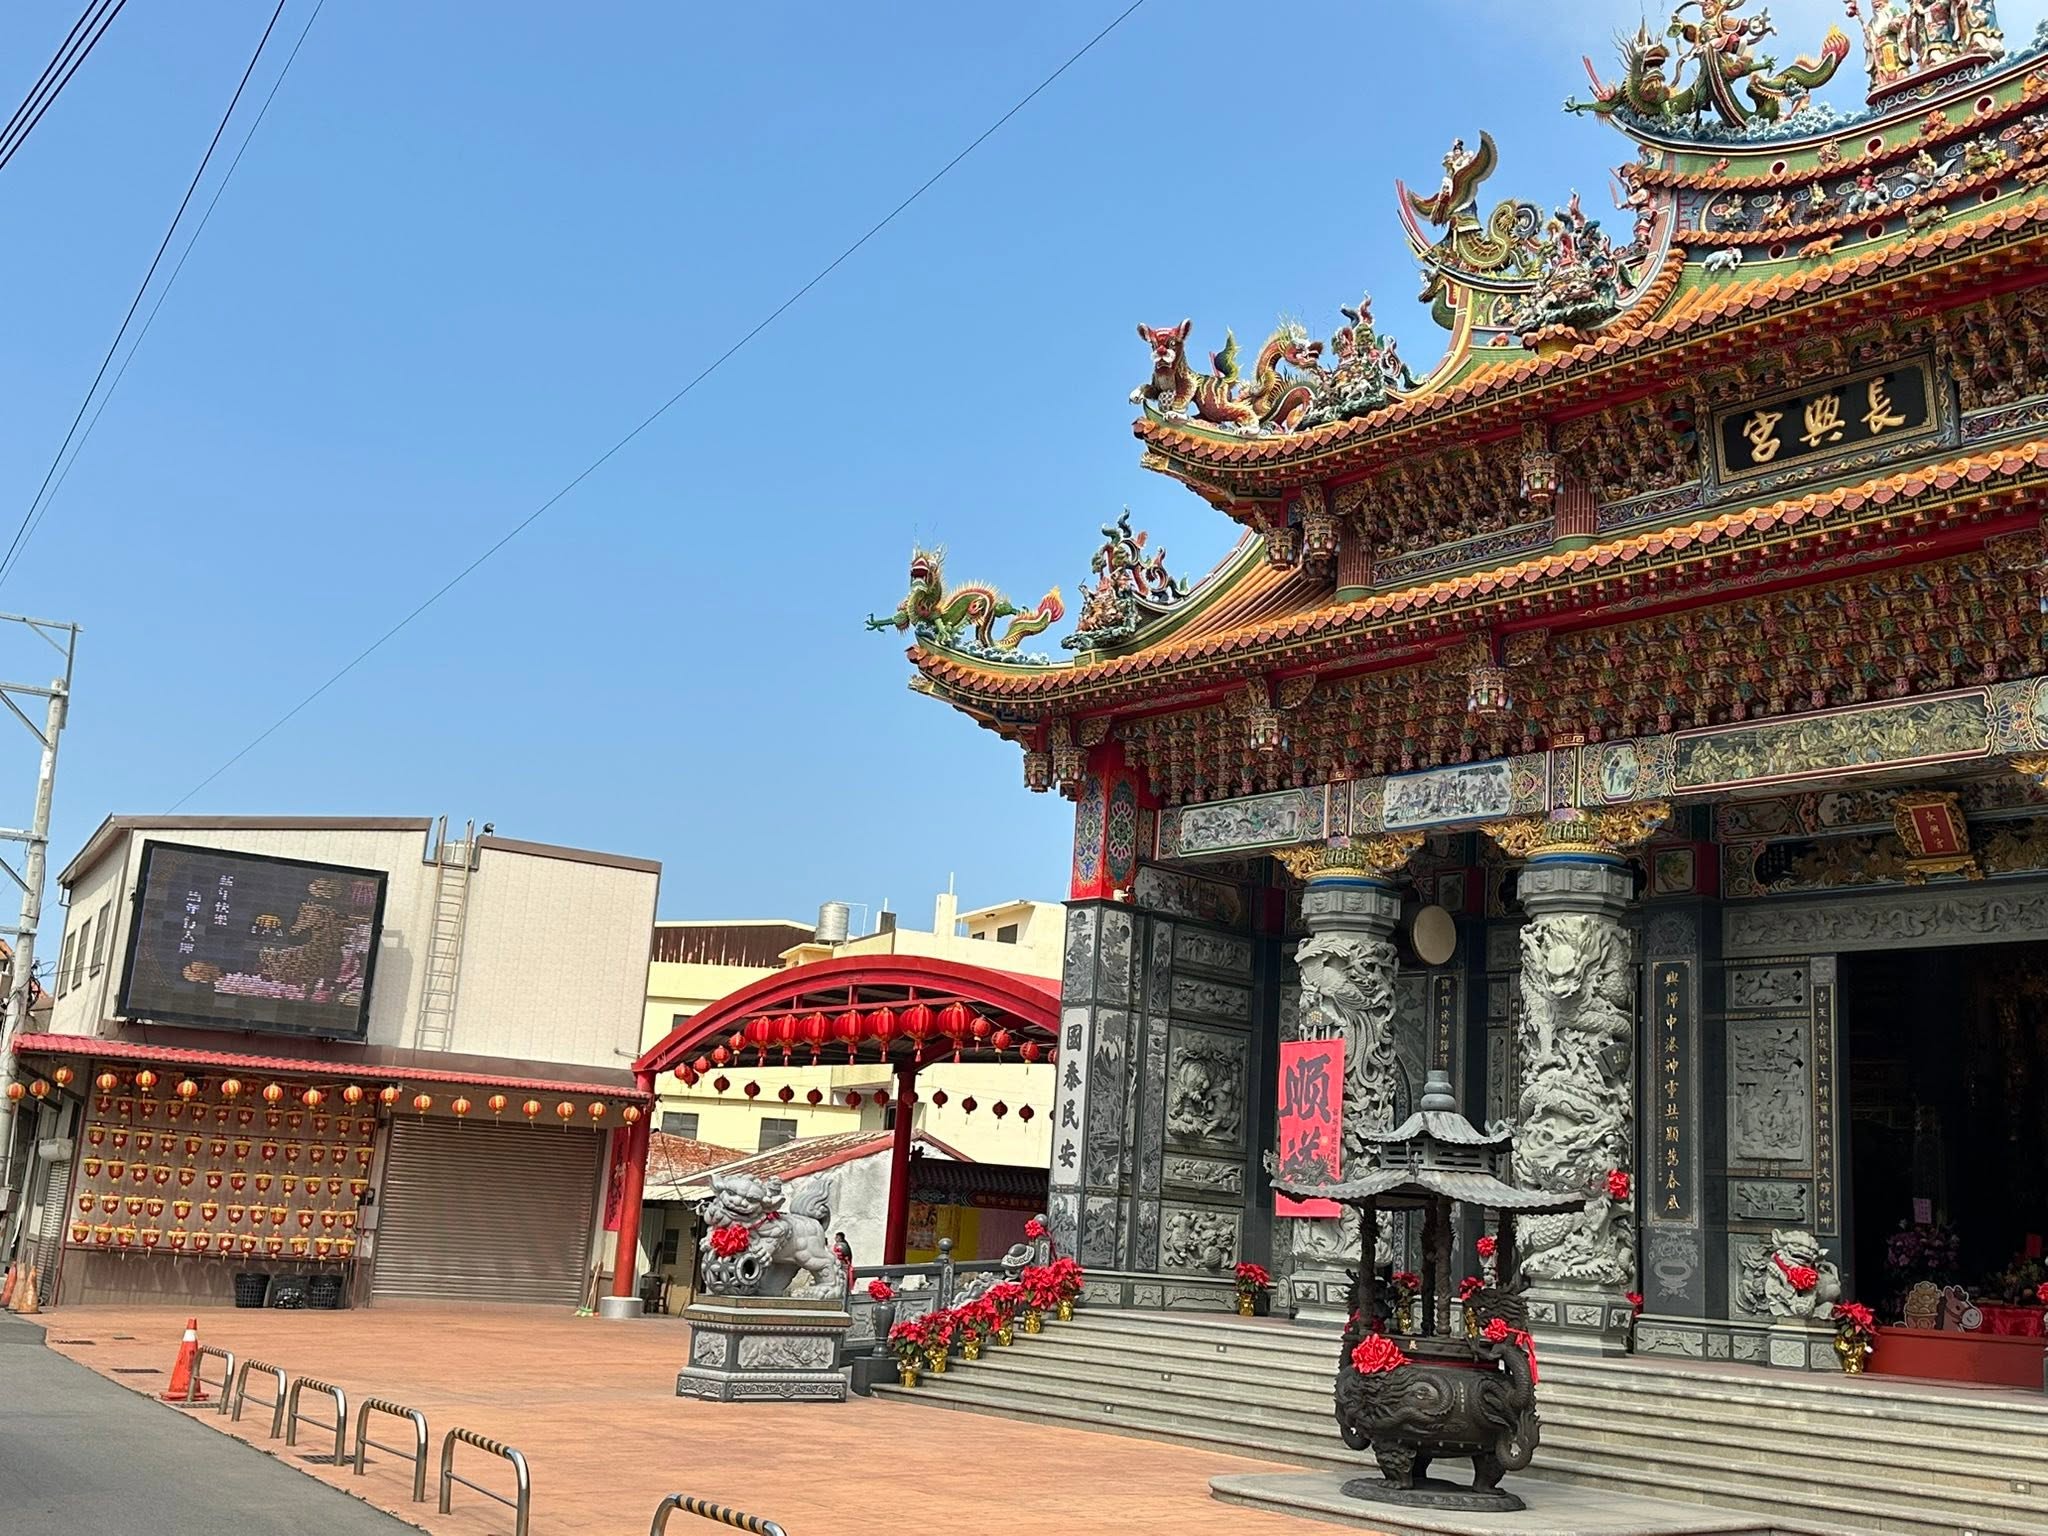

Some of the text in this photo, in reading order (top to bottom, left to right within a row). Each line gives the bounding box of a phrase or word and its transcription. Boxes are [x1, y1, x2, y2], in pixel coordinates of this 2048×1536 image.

[1743, 377, 1906, 462] 長興宮
[1058, 1024, 1082, 1168] 國泰民安
